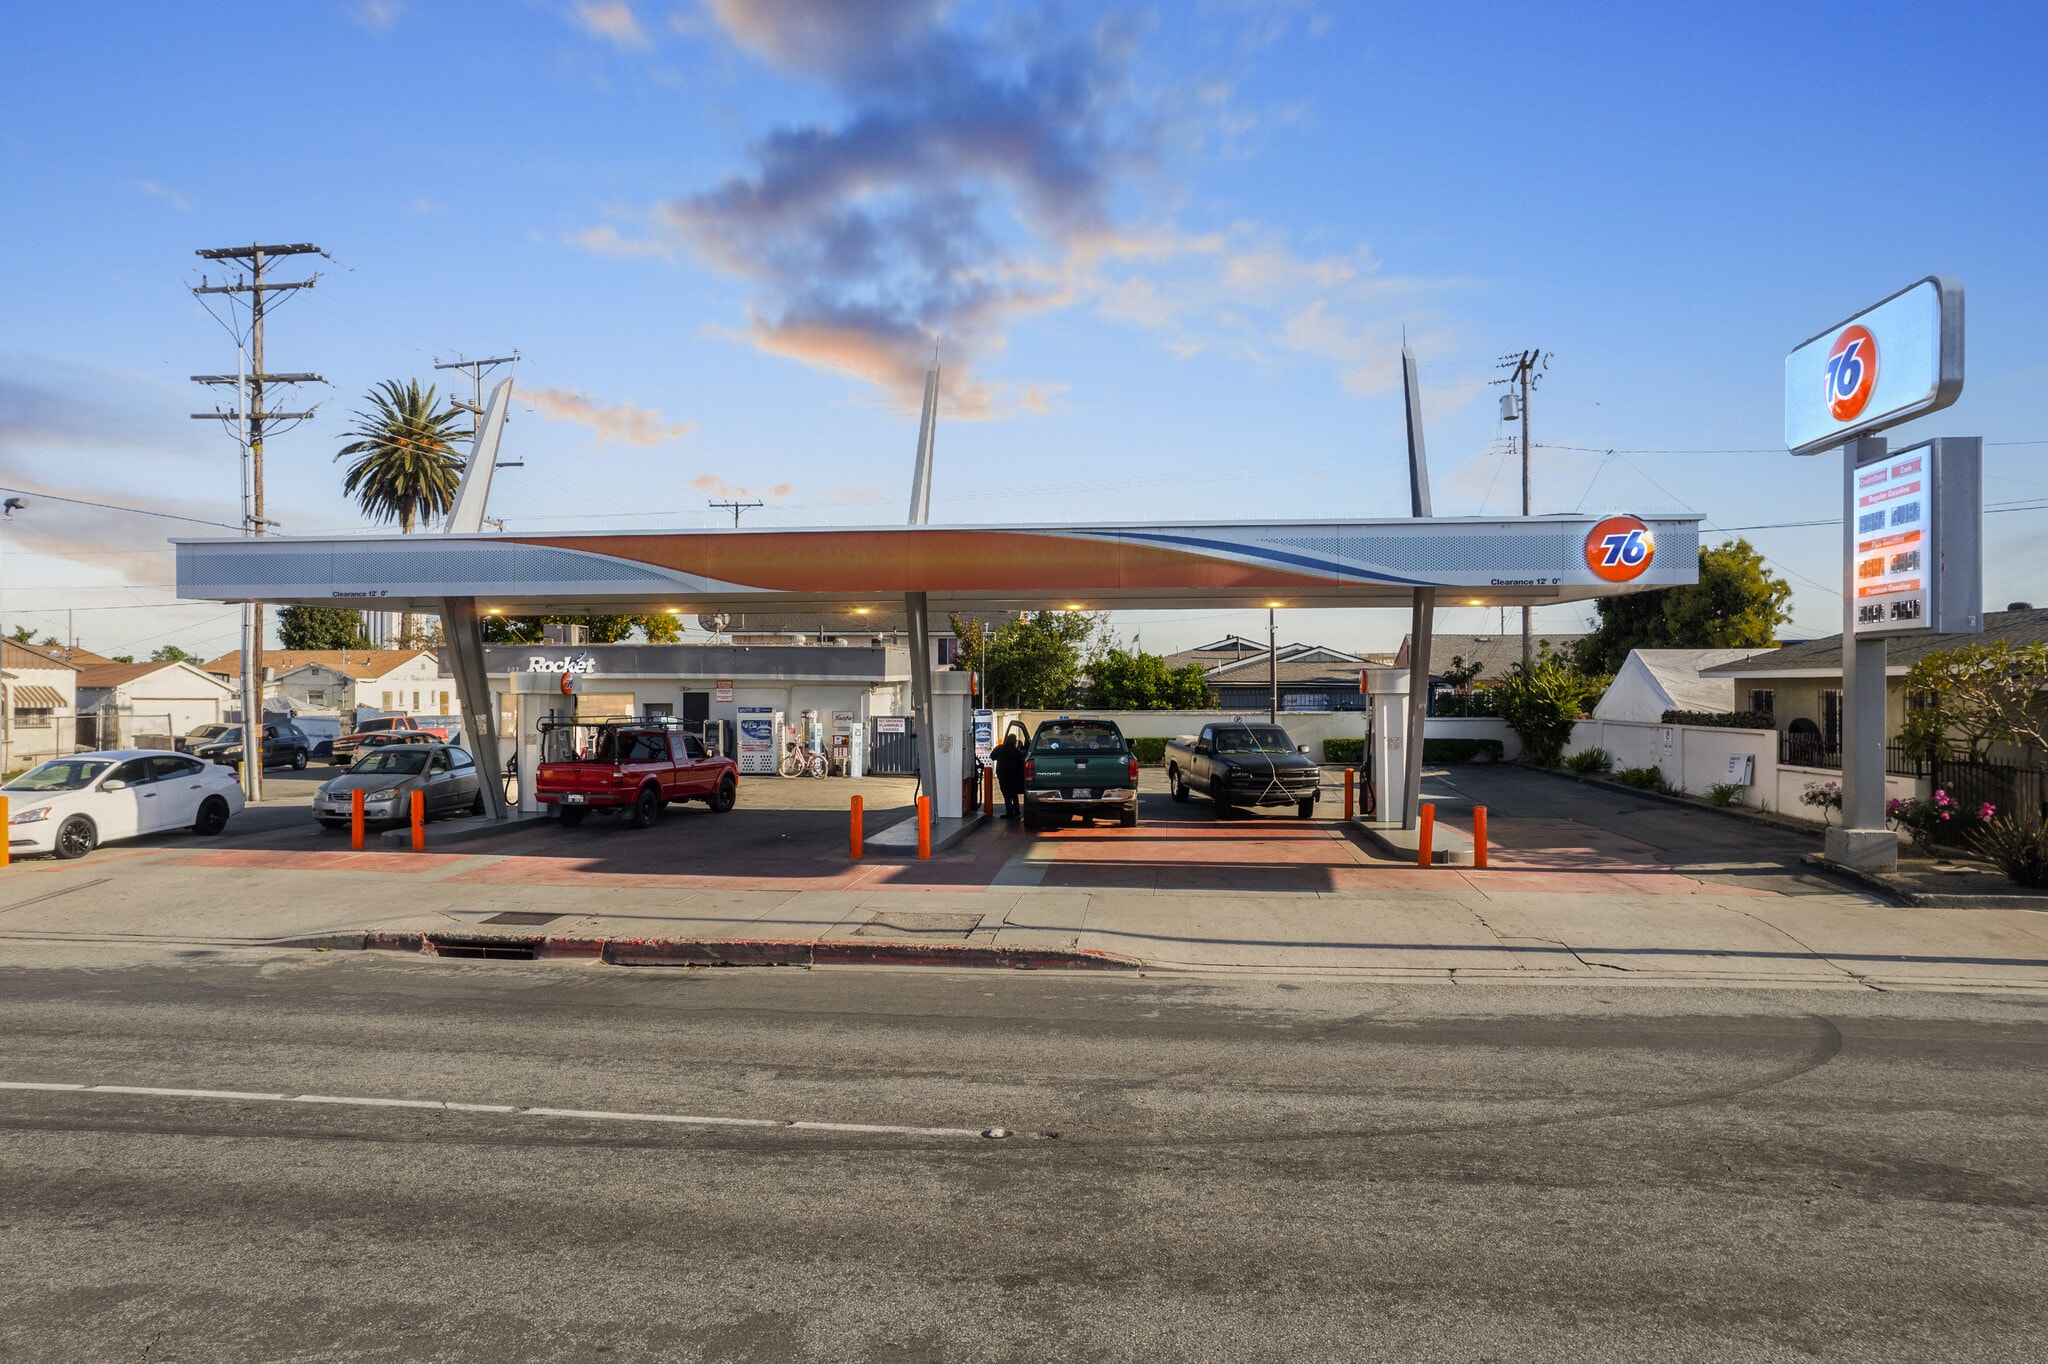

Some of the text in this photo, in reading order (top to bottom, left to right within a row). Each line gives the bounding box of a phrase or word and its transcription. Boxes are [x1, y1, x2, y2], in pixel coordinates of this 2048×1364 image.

[1825, 337, 1866, 407] 76
[1860, 465, 1912, 486] Credit/Debit Cash
[1868, 485, 1910, 504] Regular Gasoline
[1601, 529, 1648, 567] 76
[1882, 535, 1905, 546] Gasoline
[1490, 578, 1534, 586] Clearance
[1866, 583, 1911, 596] Premium Gasoline
[527, 656, 596, 673] Rocket
